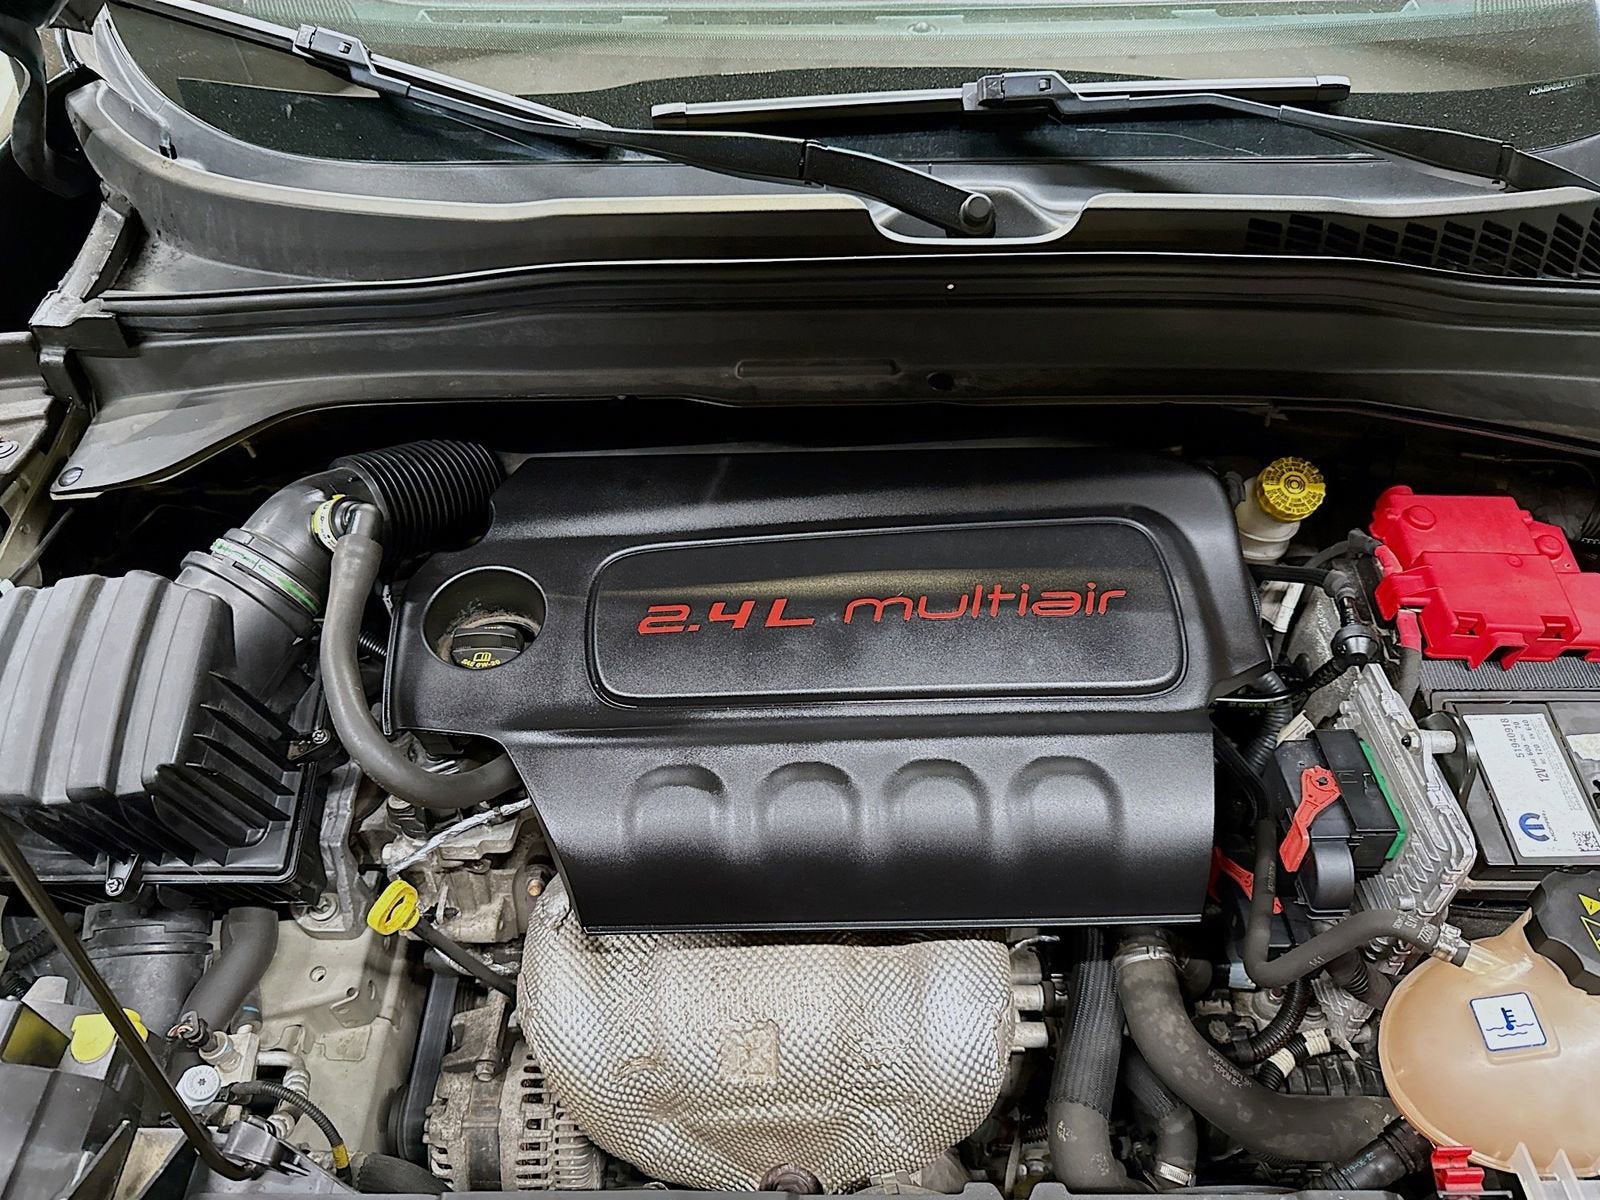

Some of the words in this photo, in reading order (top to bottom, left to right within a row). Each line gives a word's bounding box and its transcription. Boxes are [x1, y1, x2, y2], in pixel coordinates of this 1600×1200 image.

[844, 582, 1128, 624] multiair
[461, 659, 476, 667] SAE
[1500, 717, 1525, 758] 51940918
[1534, 767, 1550, 783] 12V
